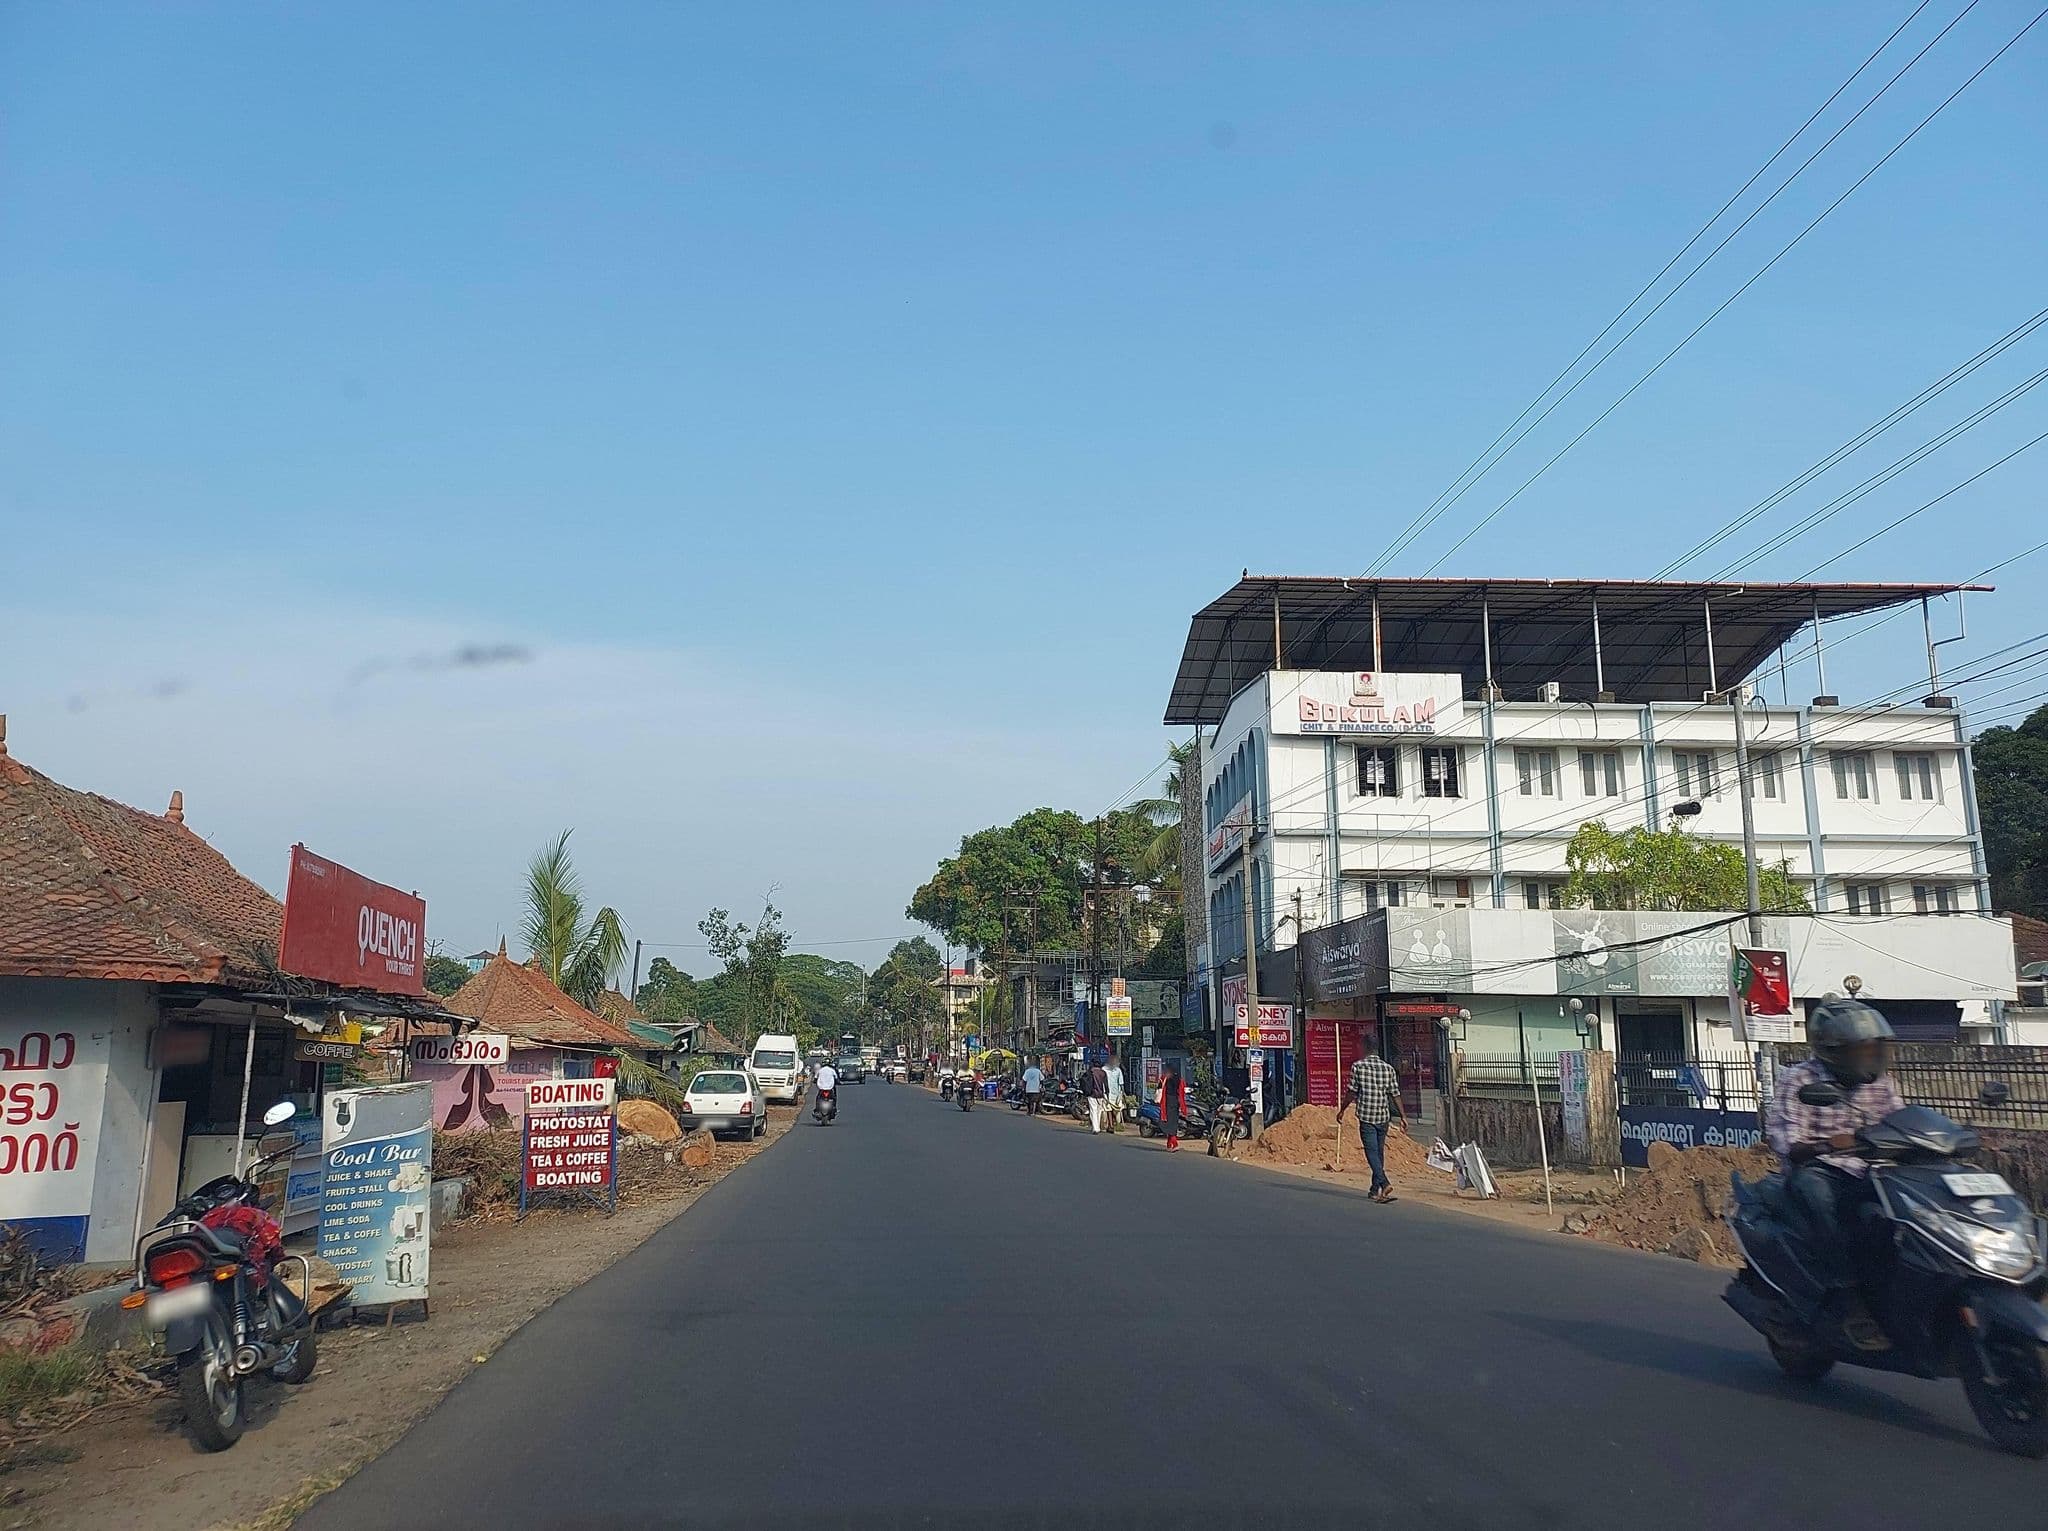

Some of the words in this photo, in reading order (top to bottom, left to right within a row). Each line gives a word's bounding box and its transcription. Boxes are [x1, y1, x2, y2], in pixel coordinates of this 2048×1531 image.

[1299, 695, 1435, 724] GOKULAM
[1339, 723, 1380, 732] FINANCE
[1641, 922, 1668, 931] Online
[358, 905, 417, 966] QUENCH
[385, 959, 399, 973] YOUR
[398, 961, 415, 976] THIRST
[1223, 980, 1247, 1006] SYDNE
[1238, 1007, 1289, 1019] SDNEY
[416, 1040, 501, 1060] സംഭാരം
[530, 1084, 604, 1104] BOATING
[531, 1116, 611, 1130] PHOTOSTAT
[530, 1135, 569, 1149] FRESH
[572, 1134, 609, 1147] JUICE
[330, 1146, 374, 1168] Cool
[380, 1144, 422, 1162] Bar
[531, 1155, 551, 1168] TEA
[555, 1153, 563, 1166] &
[566, 1152, 608, 1165] COFFEE
[326, 1171, 352, 1182] JUICE
[354, 1170, 361, 1180] &
[364, 1168, 393, 1179] SHAKE
[536, 1171, 602, 1186] BOATING
[325, 1186, 356, 1198] FRUITS
[358, 1183, 384, 1194] STALL
[324, 1201, 349, 1212] COOL
[351, 1198, 384, 1209] DRINKS
[324, 1217, 345, 1227] LIME
[347, 1215, 371, 1225] SODA
[323, 1232, 341, 1243] TEA
[343, 1231, 350, 1240] &
[353, 1228, 382, 1239] COFFE
[323, 1246, 358, 1258] SNACKS
[334, 1259, 373, 1271] OTOSTAT
[338, 1274, 375, 1285] TIONARY
